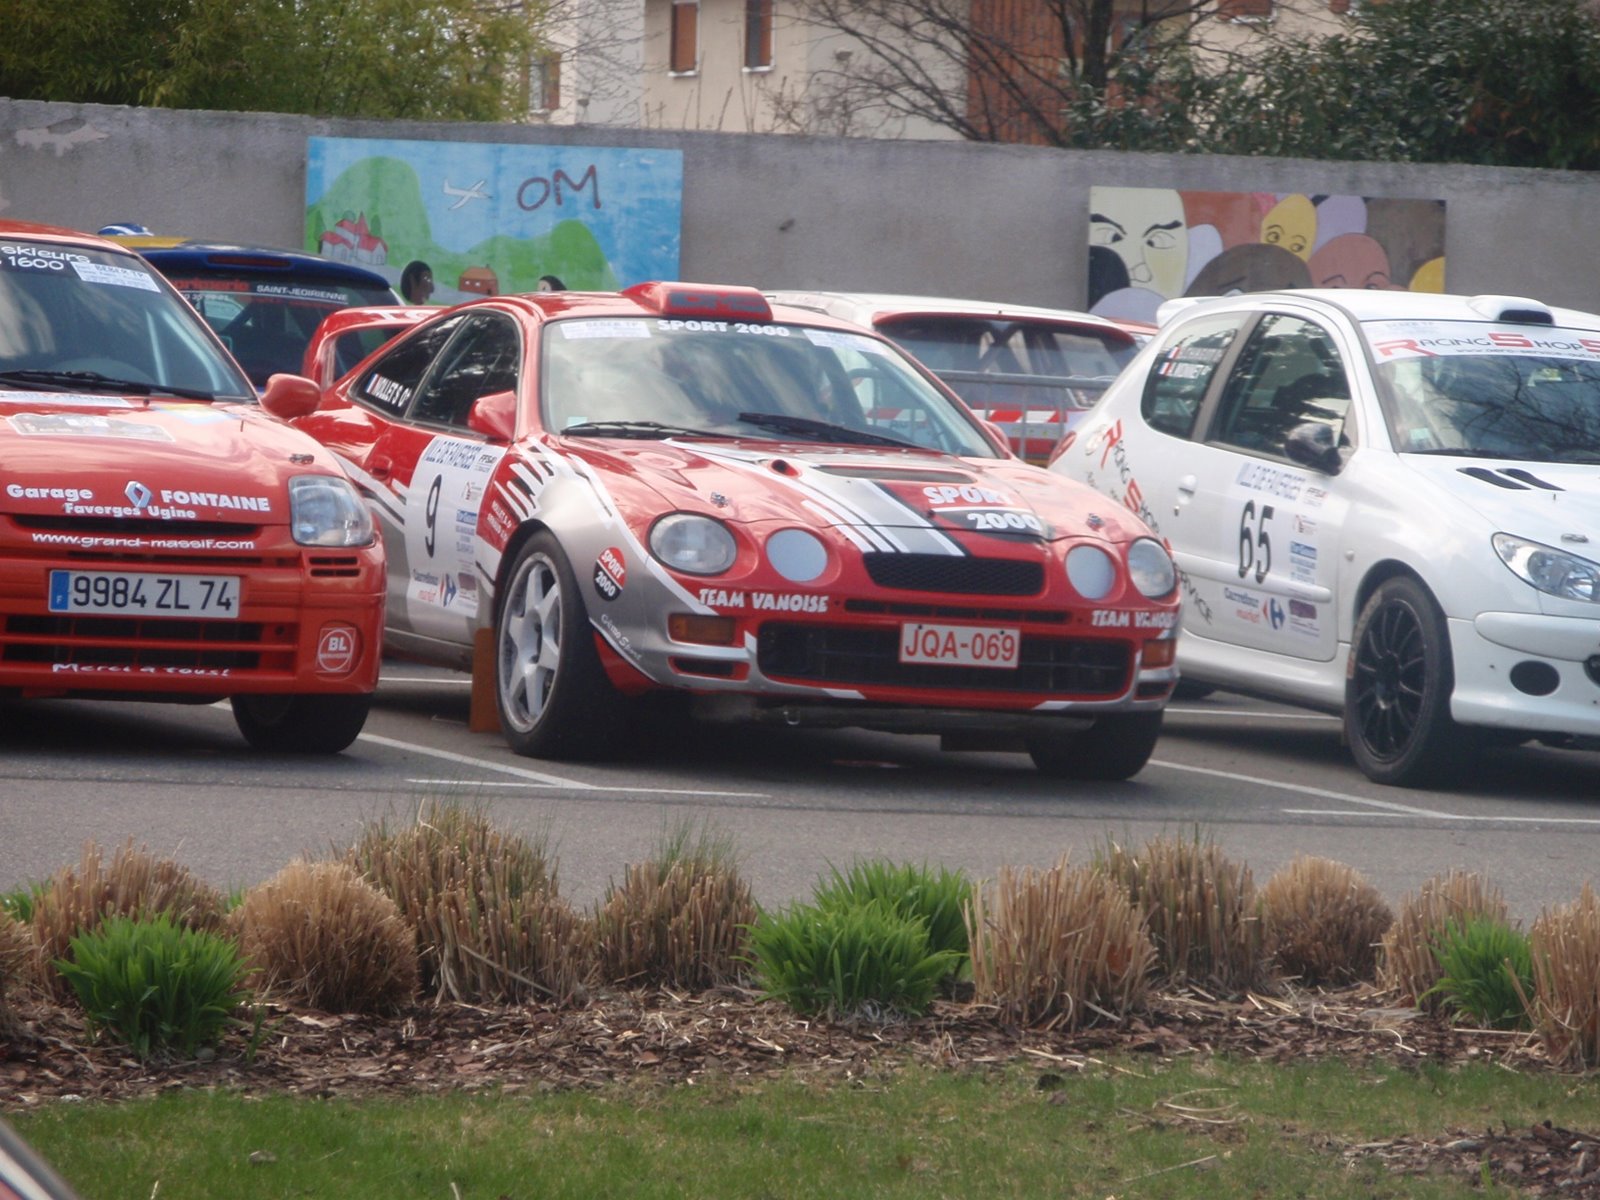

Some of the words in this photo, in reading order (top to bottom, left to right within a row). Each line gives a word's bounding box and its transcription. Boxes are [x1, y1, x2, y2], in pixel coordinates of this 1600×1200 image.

[517, 164, 601, 211] OM
[1, 246, 90, 264] skieurs
[8, 256, 64, 270] 1600
[658, 319, 728, 333] SPORT
[736, 322, 791, 337] 2000
[6, 484, 94, 502] Garage
[160, 489, 271, 513] FONTAINE
[922, 485, 1014, 505] SPORT
[64, 502, 141, 519] Faverges
[147, 504, 197, 520] Ugine
[425, 474, 443, 558] 9
[966, 512, 1045, 532] 2000
[32, 532, 255, 550] www.grand-massif.com
[1239, 499, 1275, 584] 65
[601, 549, 626, 579] SPORT
[72, 574, 148, 609] 9984
[155, 578, 190, 611] ZL
[199, 580, 233, 612] 74
[594, 570, 616, 597] 2000
[699, 589, 745, 608] TEAM
[752, 592, 830, 613] VANOISE
[1091, 609, 1130, 628] TEAM
[328, 637, 347, 652] BL
[904, 629, 1015, 662] JQA-069
[52, 662, 131, 673] Merci
